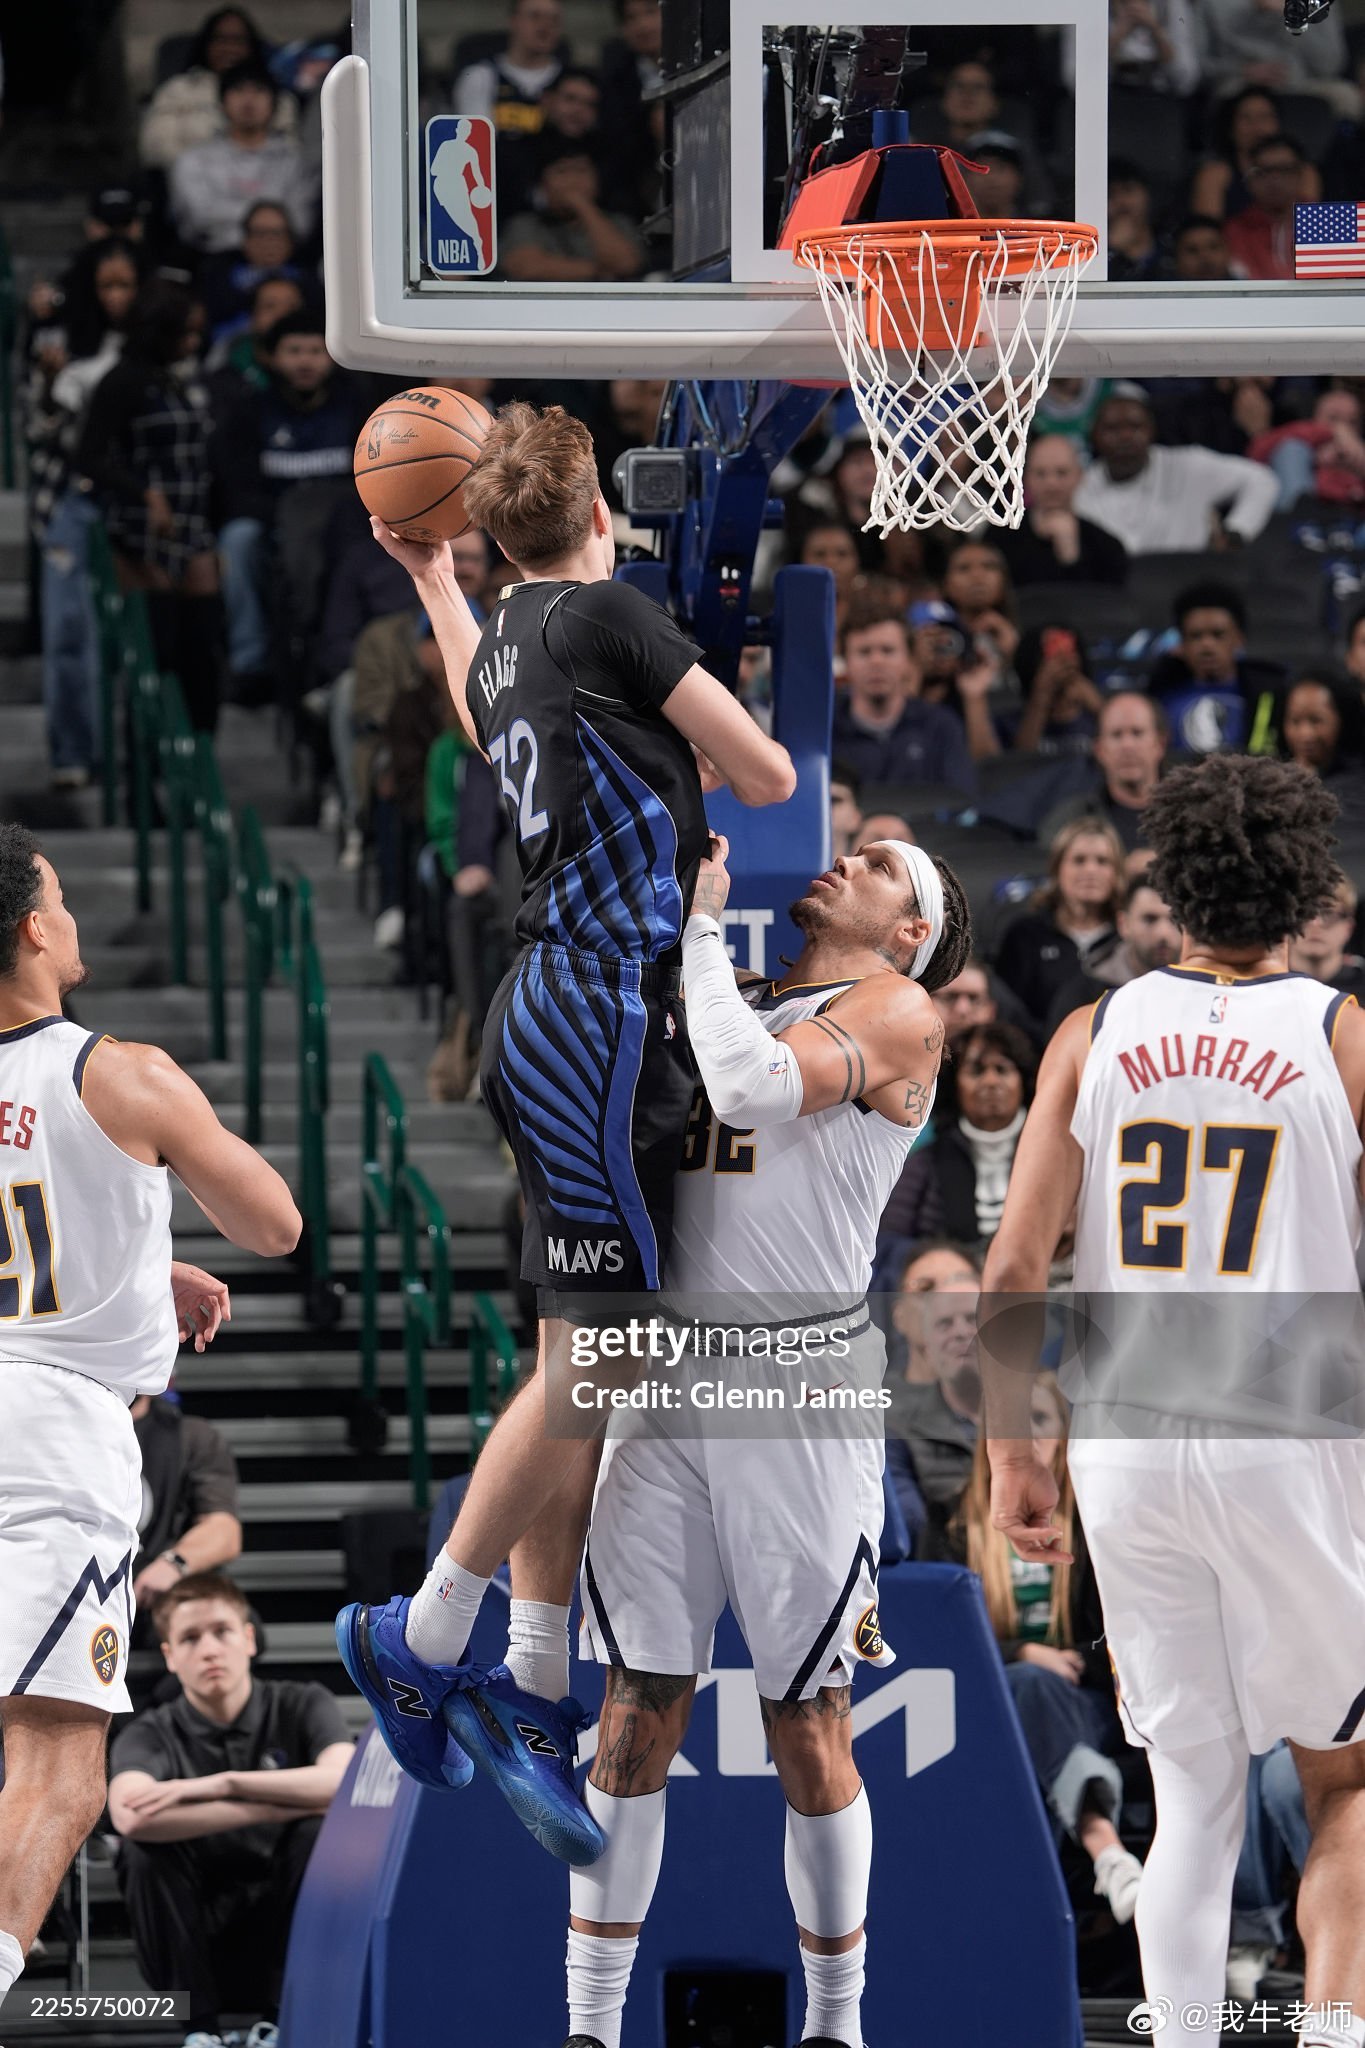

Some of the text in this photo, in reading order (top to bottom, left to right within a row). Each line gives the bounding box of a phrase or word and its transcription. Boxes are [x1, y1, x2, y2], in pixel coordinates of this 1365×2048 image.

[438, 239, 470, 264] NBA
[478, 645, 518, 709] FLAGG
[487, 717, 549, 843] 32
[1118, 1034, 1305, 1102] MURRAY
[1118, 1117, 1283, 1276] 27
[547, 1236, 624, 1273] MAVS
